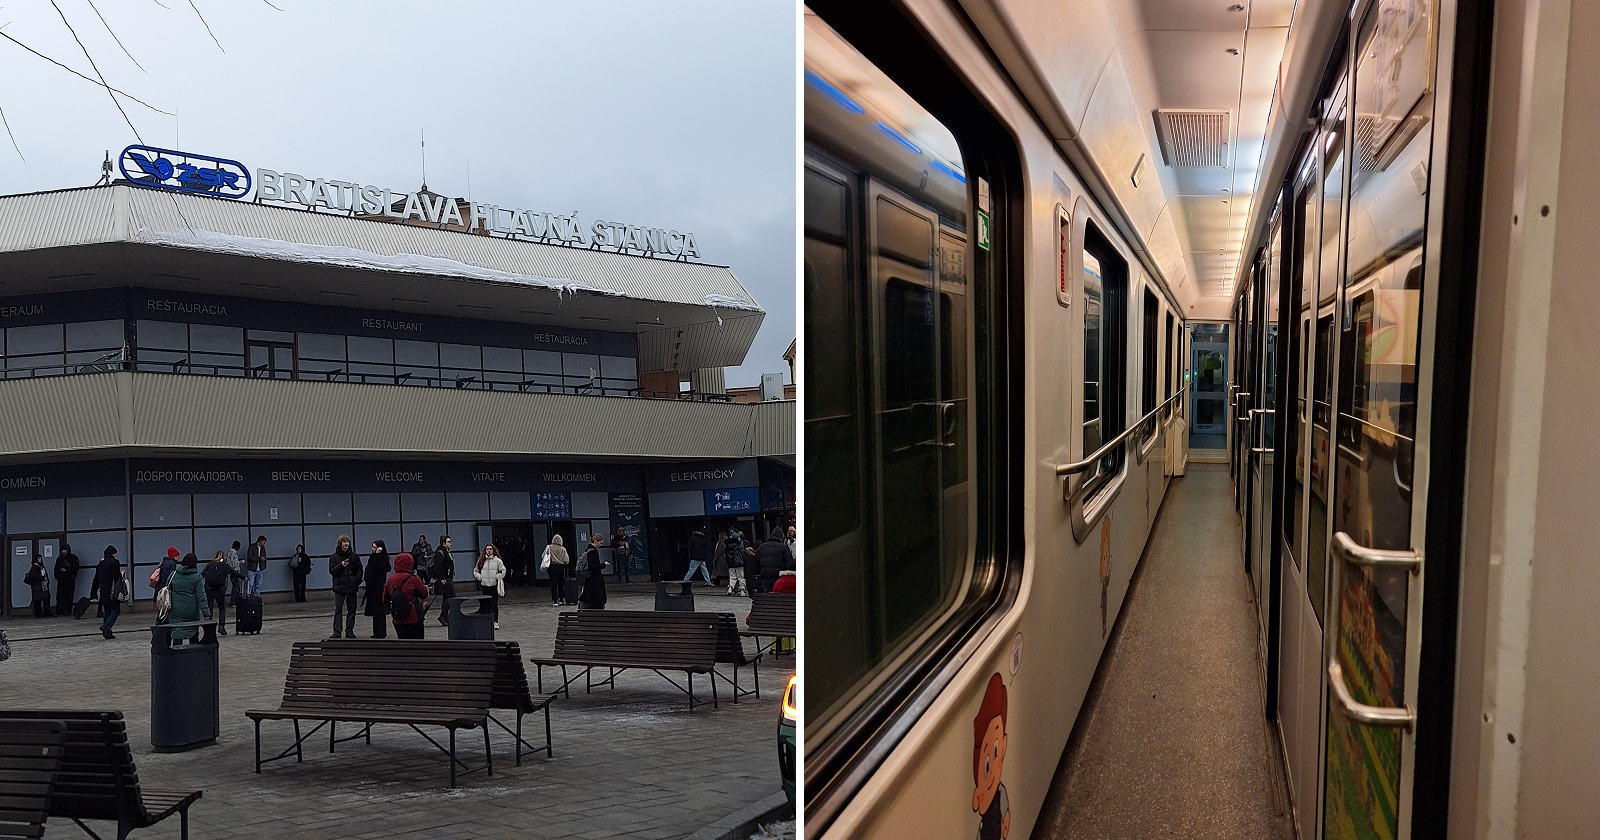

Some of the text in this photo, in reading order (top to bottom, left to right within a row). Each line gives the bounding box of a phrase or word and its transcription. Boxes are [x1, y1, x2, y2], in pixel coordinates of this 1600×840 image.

[176, 162, 240, 191] ŽSR
[256, 167, 701, 259] BRATISLAVA HLAVNÁ STANICA
[146, 298, 229, 317] REŠTAURÁCIA
[361, 318, 424, 333] RESTAURANT
[533, 332, 589, 346] REŠTAURÁCIA
[135, 470, 244, 484] ДОБРО ПОЖАЛОВАТЬ
[271, 471, 331, 482] BIENVENUE
[375, 472, 424, 482] WELCOME
[471, 472, 506, 482] VITAJTE
[542, 472, 597, 482] WILLKOMMEN
[670, 468, 736, 482] ELEKTRIČKY
